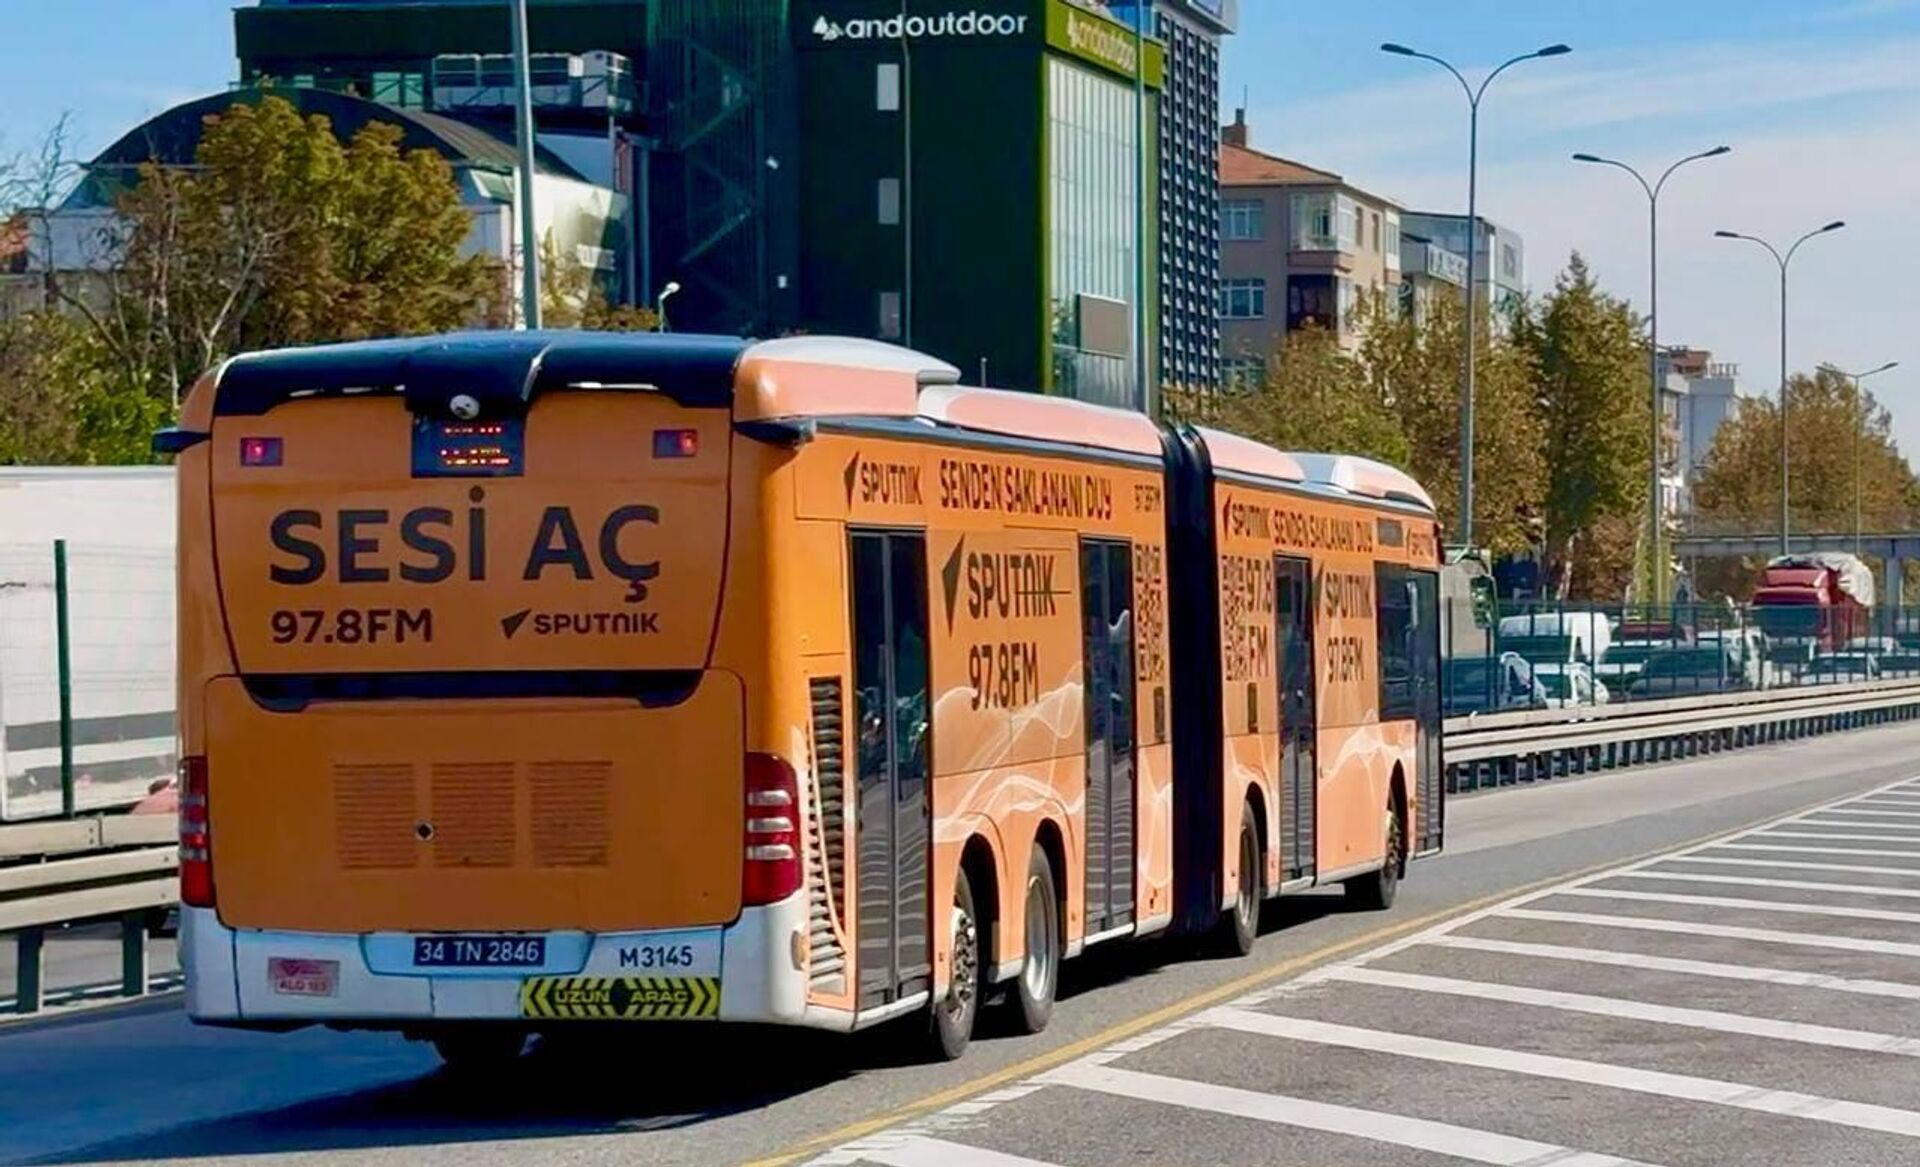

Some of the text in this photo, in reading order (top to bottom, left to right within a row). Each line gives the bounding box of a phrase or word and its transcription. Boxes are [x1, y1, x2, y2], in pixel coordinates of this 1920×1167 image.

[845, 10, 1027, 38] andoutdoor
[860, 461, 922, 505] SPUTNIK
[939, 458, 1002, 510] SENDEN
[1004, 466, 1083, 518] SAKLANANI
[269, 485, 661, 603] SESİ AÇ
[967, 552, 1056, 620] SPUTNIK
[271, 608, 433, 643] 97.8FM
[534, 611, 659, 637] SPUTNIK
[969, 642, 1039, 712] 97.8FM
[420, 941, 539, 961] 34 TN 2846
[619, 946, 693, 967] M3145
[555, 989, 610, 1003] UZUN
